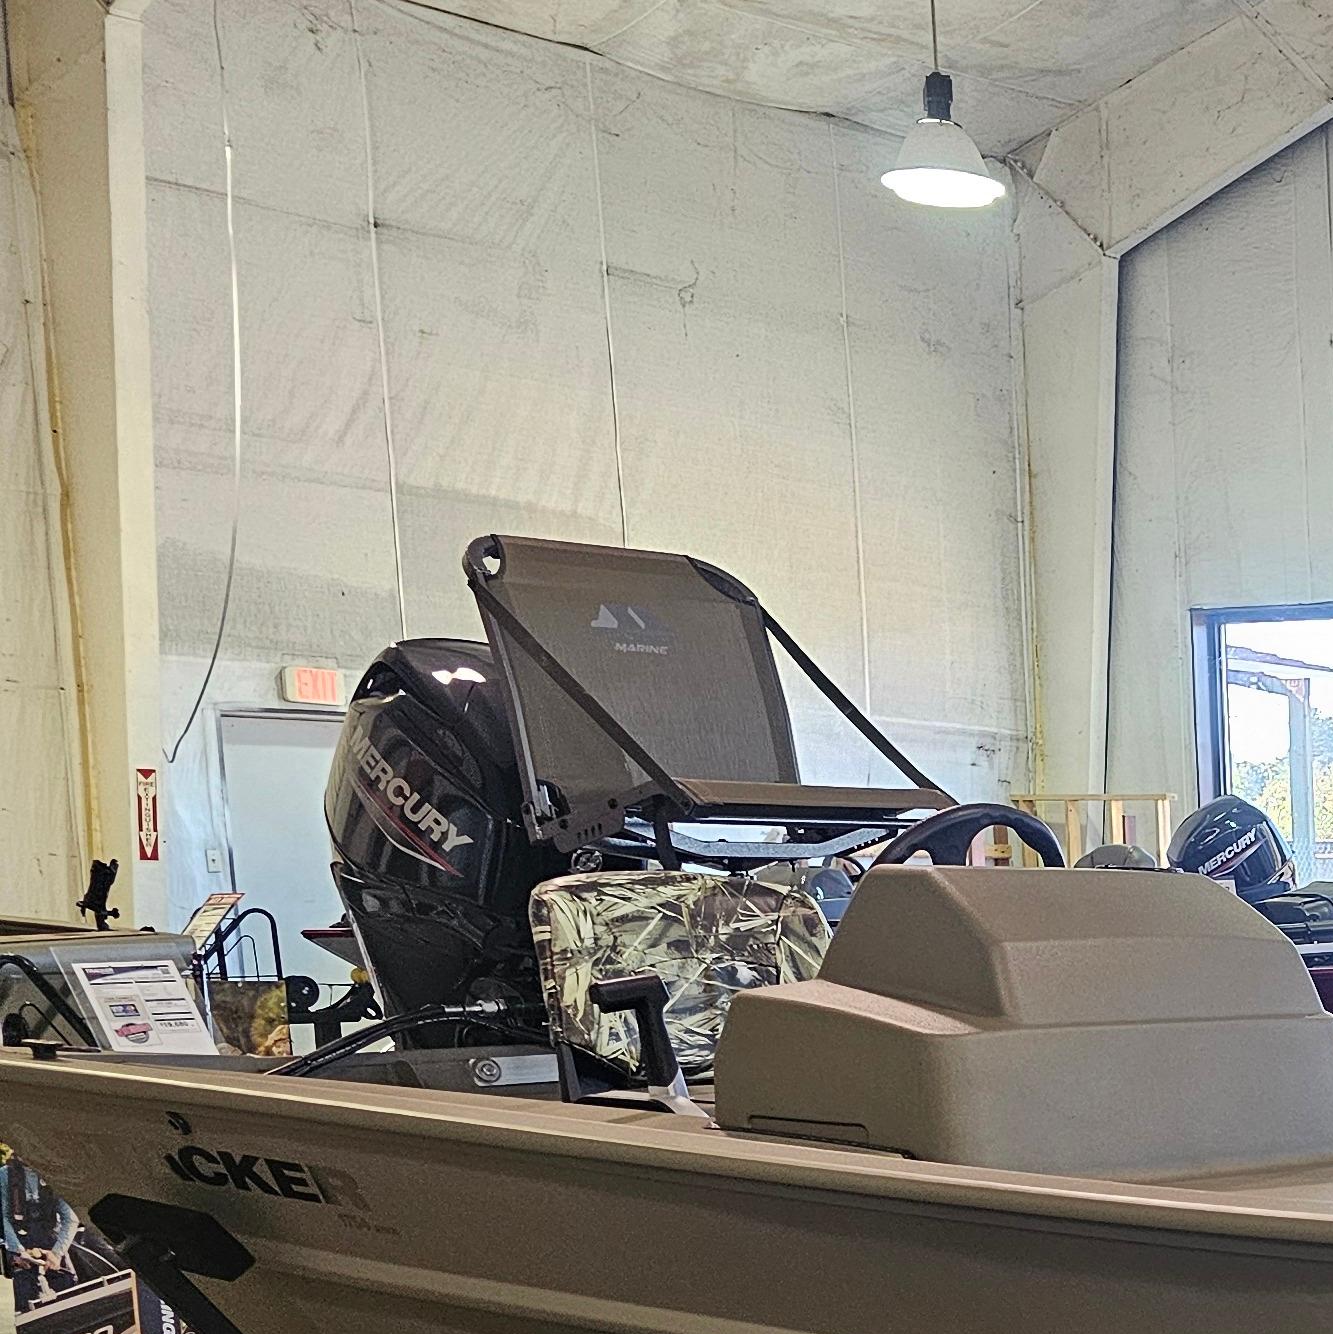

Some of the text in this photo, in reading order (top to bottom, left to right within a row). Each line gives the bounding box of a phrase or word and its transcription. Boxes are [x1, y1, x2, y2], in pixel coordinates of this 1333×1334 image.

[614, 642, 668, 655] MARINE
[296, 668, 336, 702] EXIT
[350, 727, 473, 852] MERCURY
[1198, 828, 1257, 874] MERCURY
